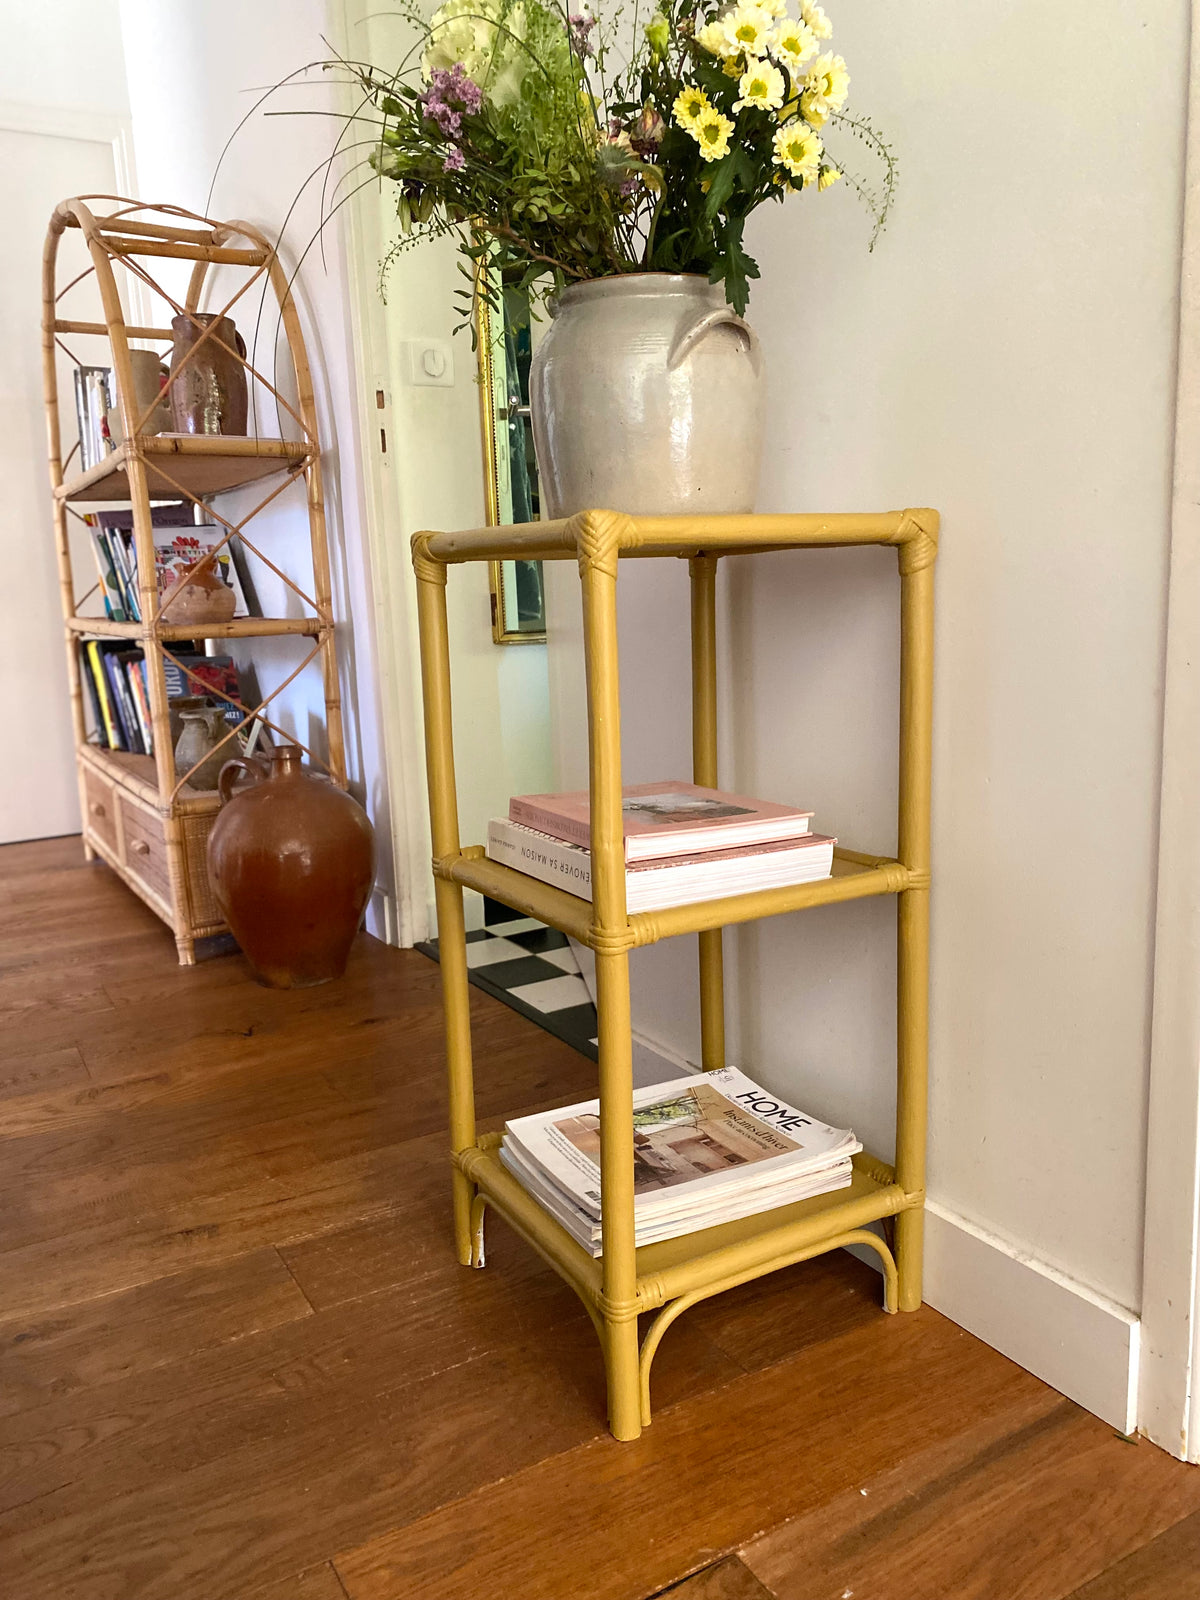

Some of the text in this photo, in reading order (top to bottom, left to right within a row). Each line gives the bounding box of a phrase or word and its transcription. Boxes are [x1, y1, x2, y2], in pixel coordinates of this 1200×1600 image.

[520, 846, 590, 884] ÉNOVER SA MAISON
[735, 1090, 812, 1132] HOME
